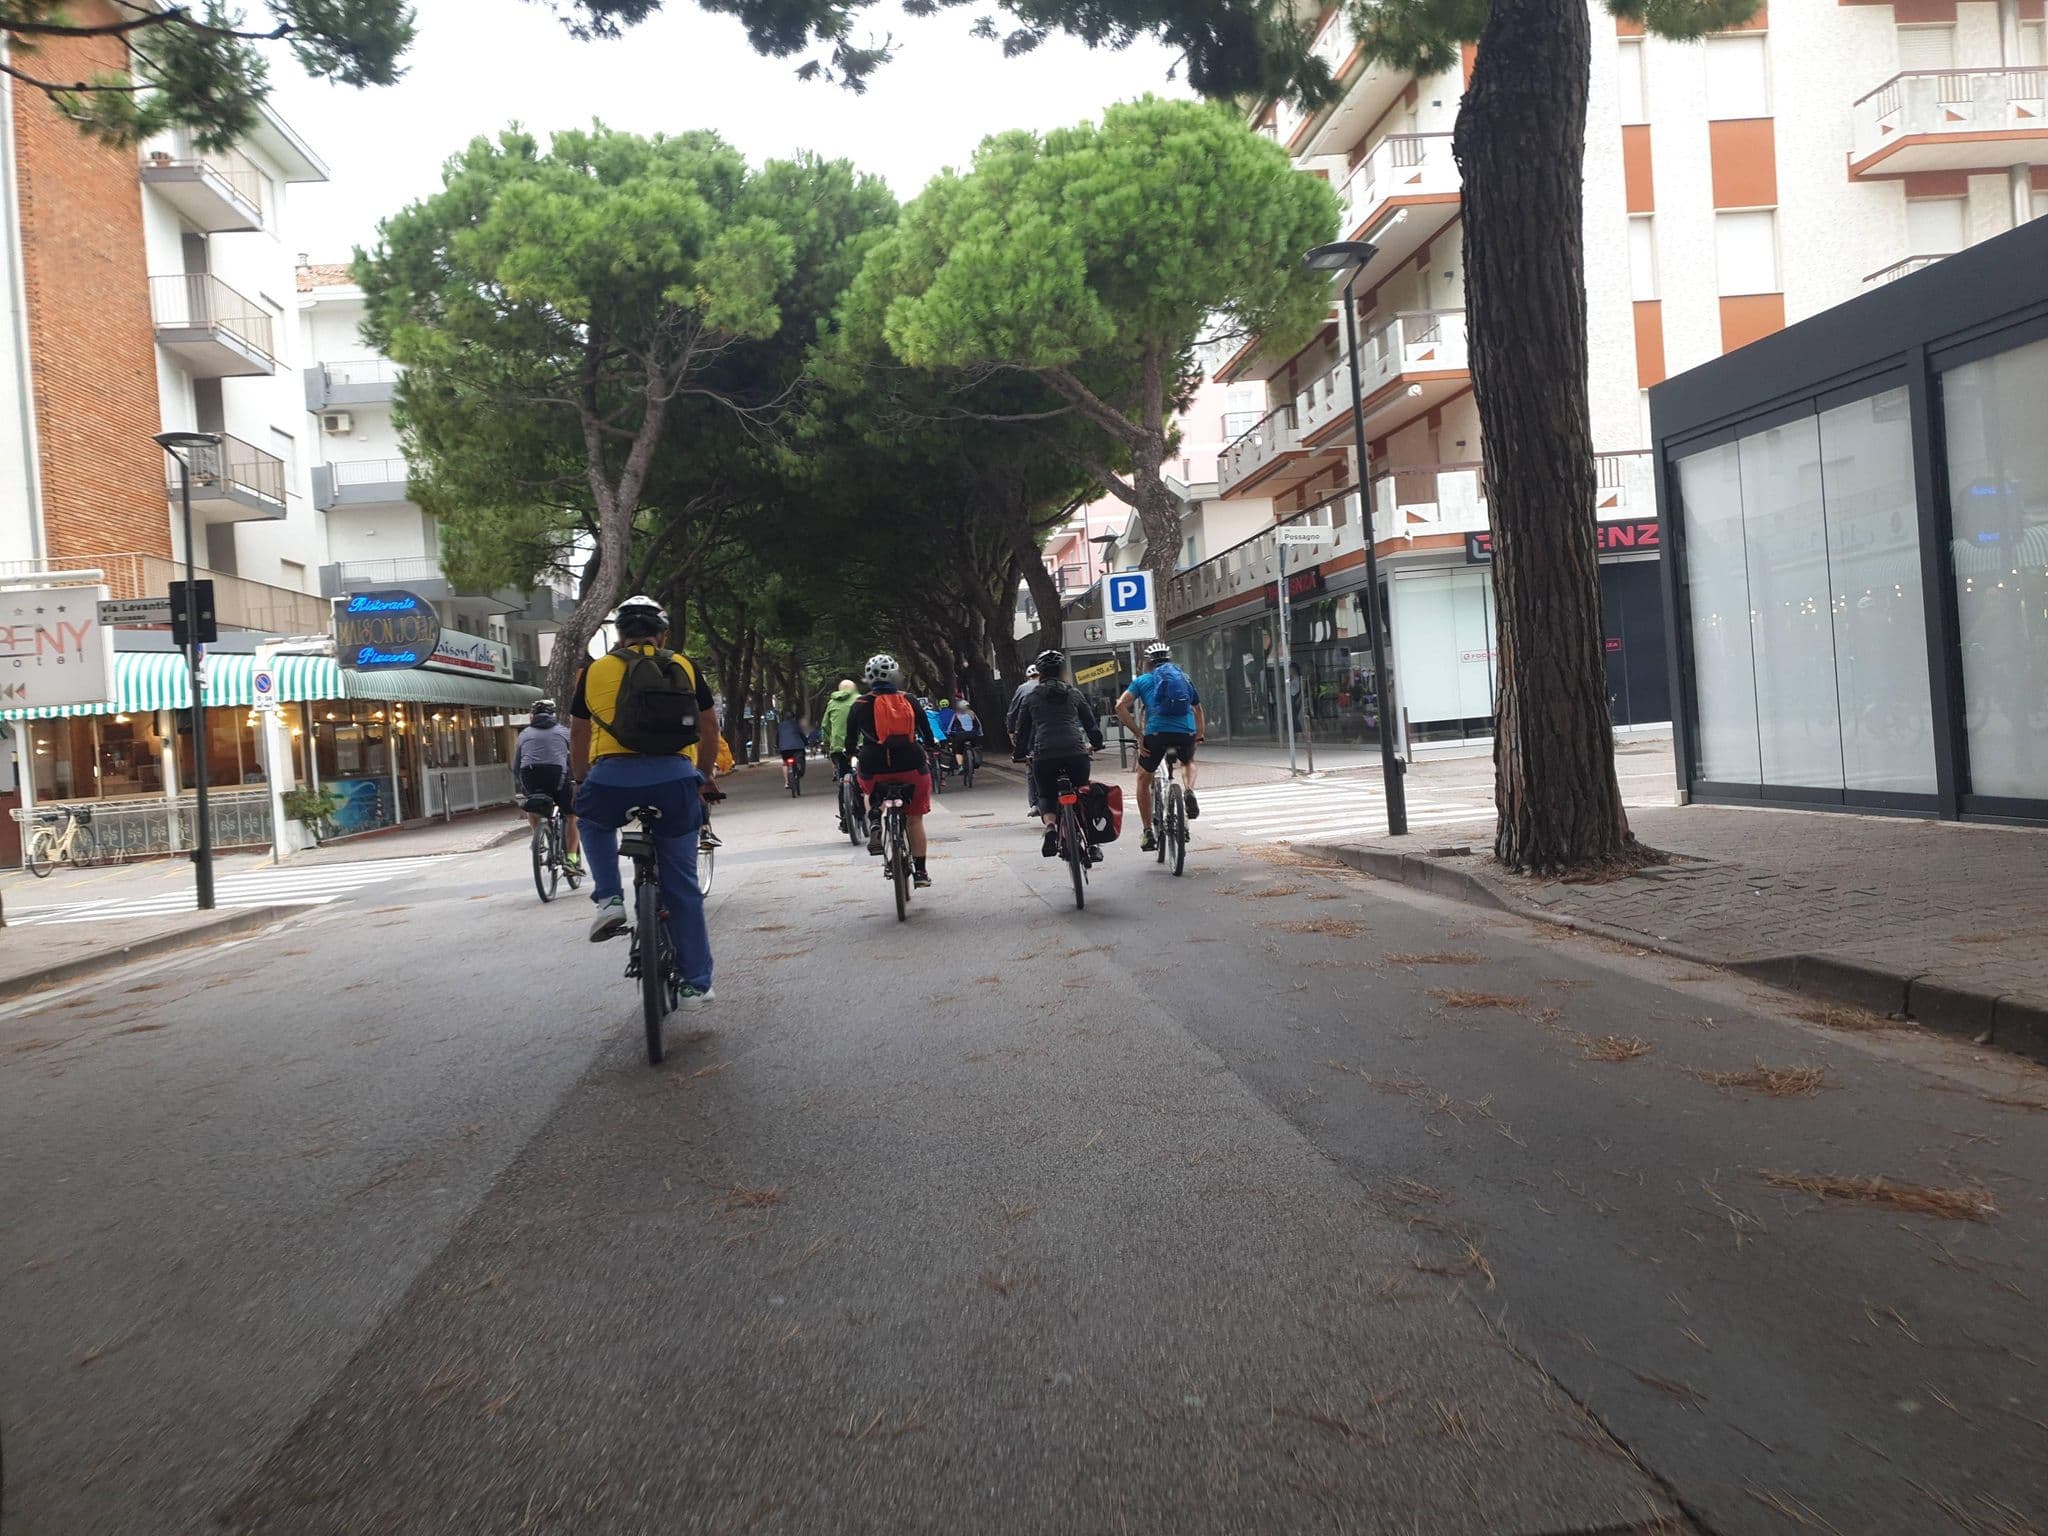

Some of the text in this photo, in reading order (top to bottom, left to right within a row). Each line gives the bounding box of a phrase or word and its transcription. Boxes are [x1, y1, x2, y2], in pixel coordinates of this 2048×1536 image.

[1284, 533, 1320, 541] Possagno
[1117, 581, 1137, 607] P
[347, 597, 416, 612] Ristorante
[356, 645, 416, 665] Pizzeria
